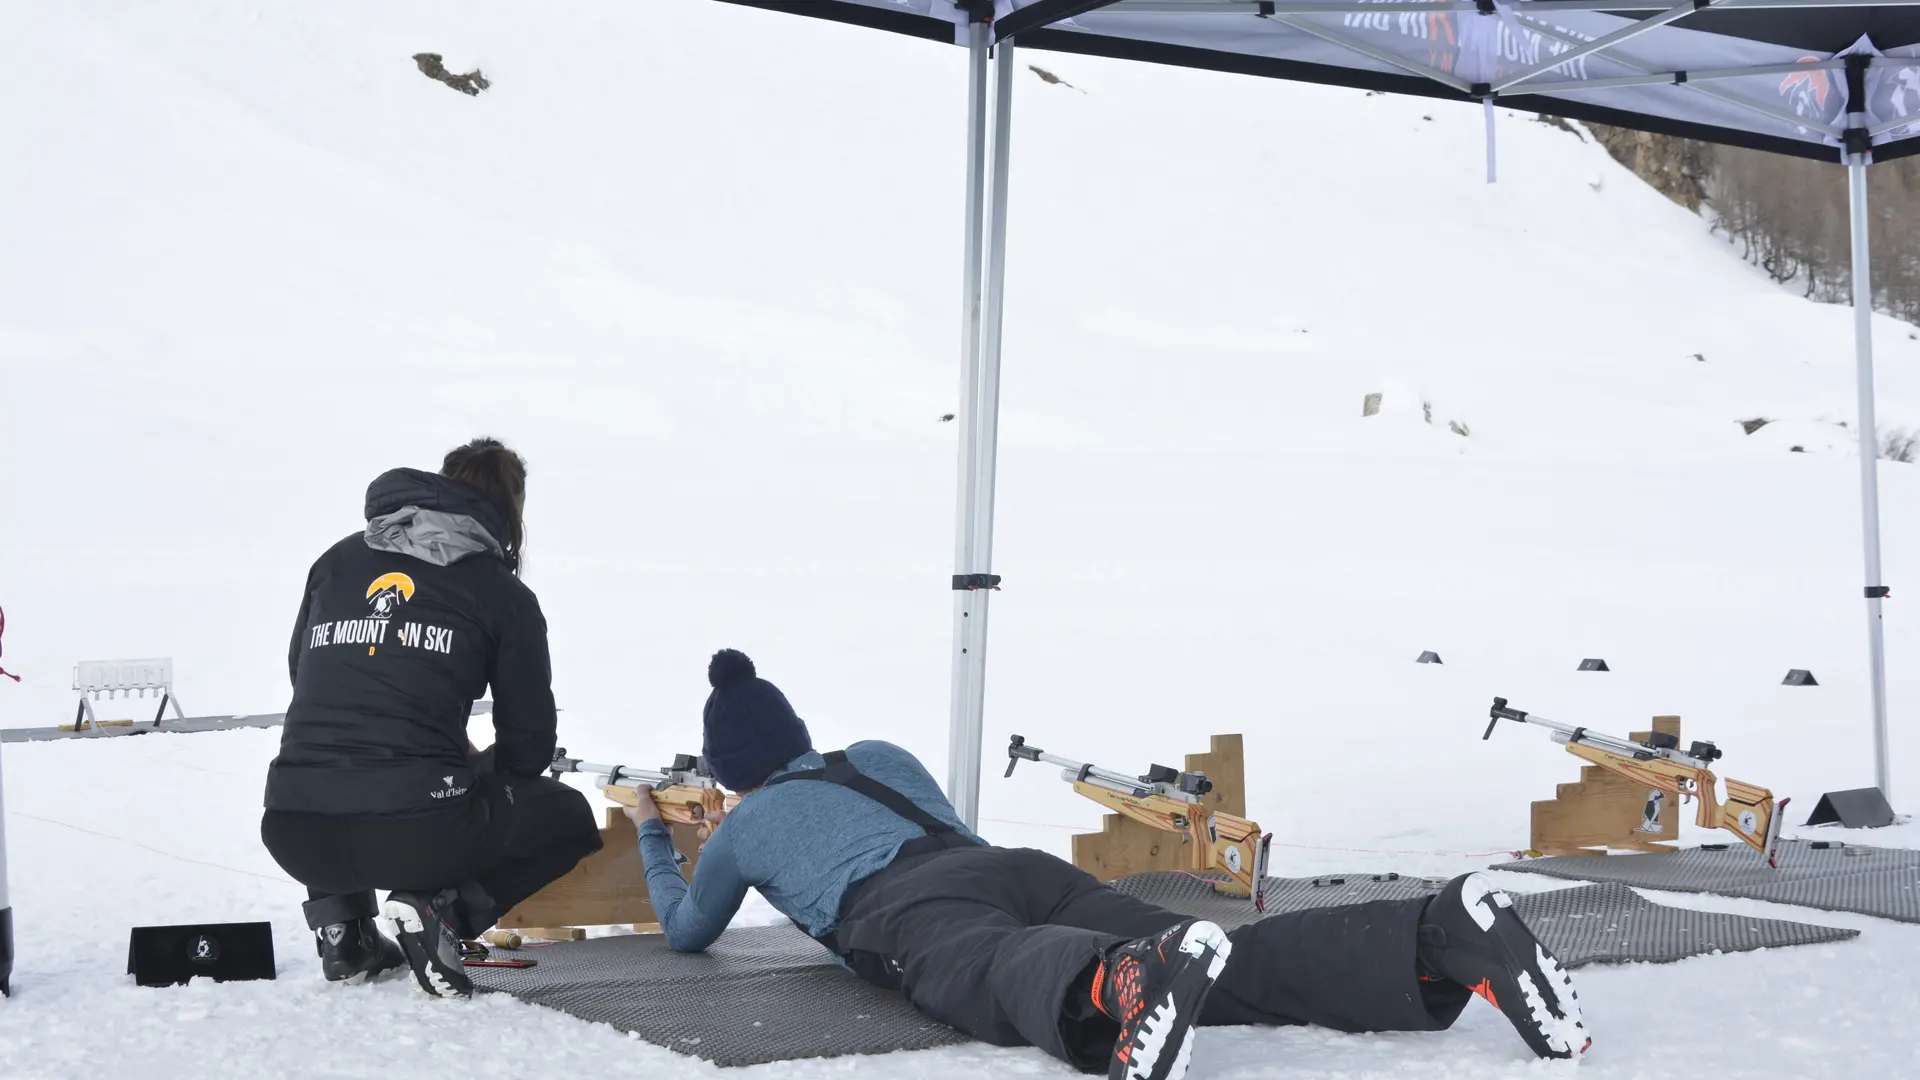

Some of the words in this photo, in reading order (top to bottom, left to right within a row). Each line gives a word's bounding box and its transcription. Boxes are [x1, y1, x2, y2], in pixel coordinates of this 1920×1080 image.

[309, 621, 333, 650] THE
[332, 619, 422, 648] MOUNTIN
[423, 625, 453, 654] SKI
[430, 789, 444, 799] Val
